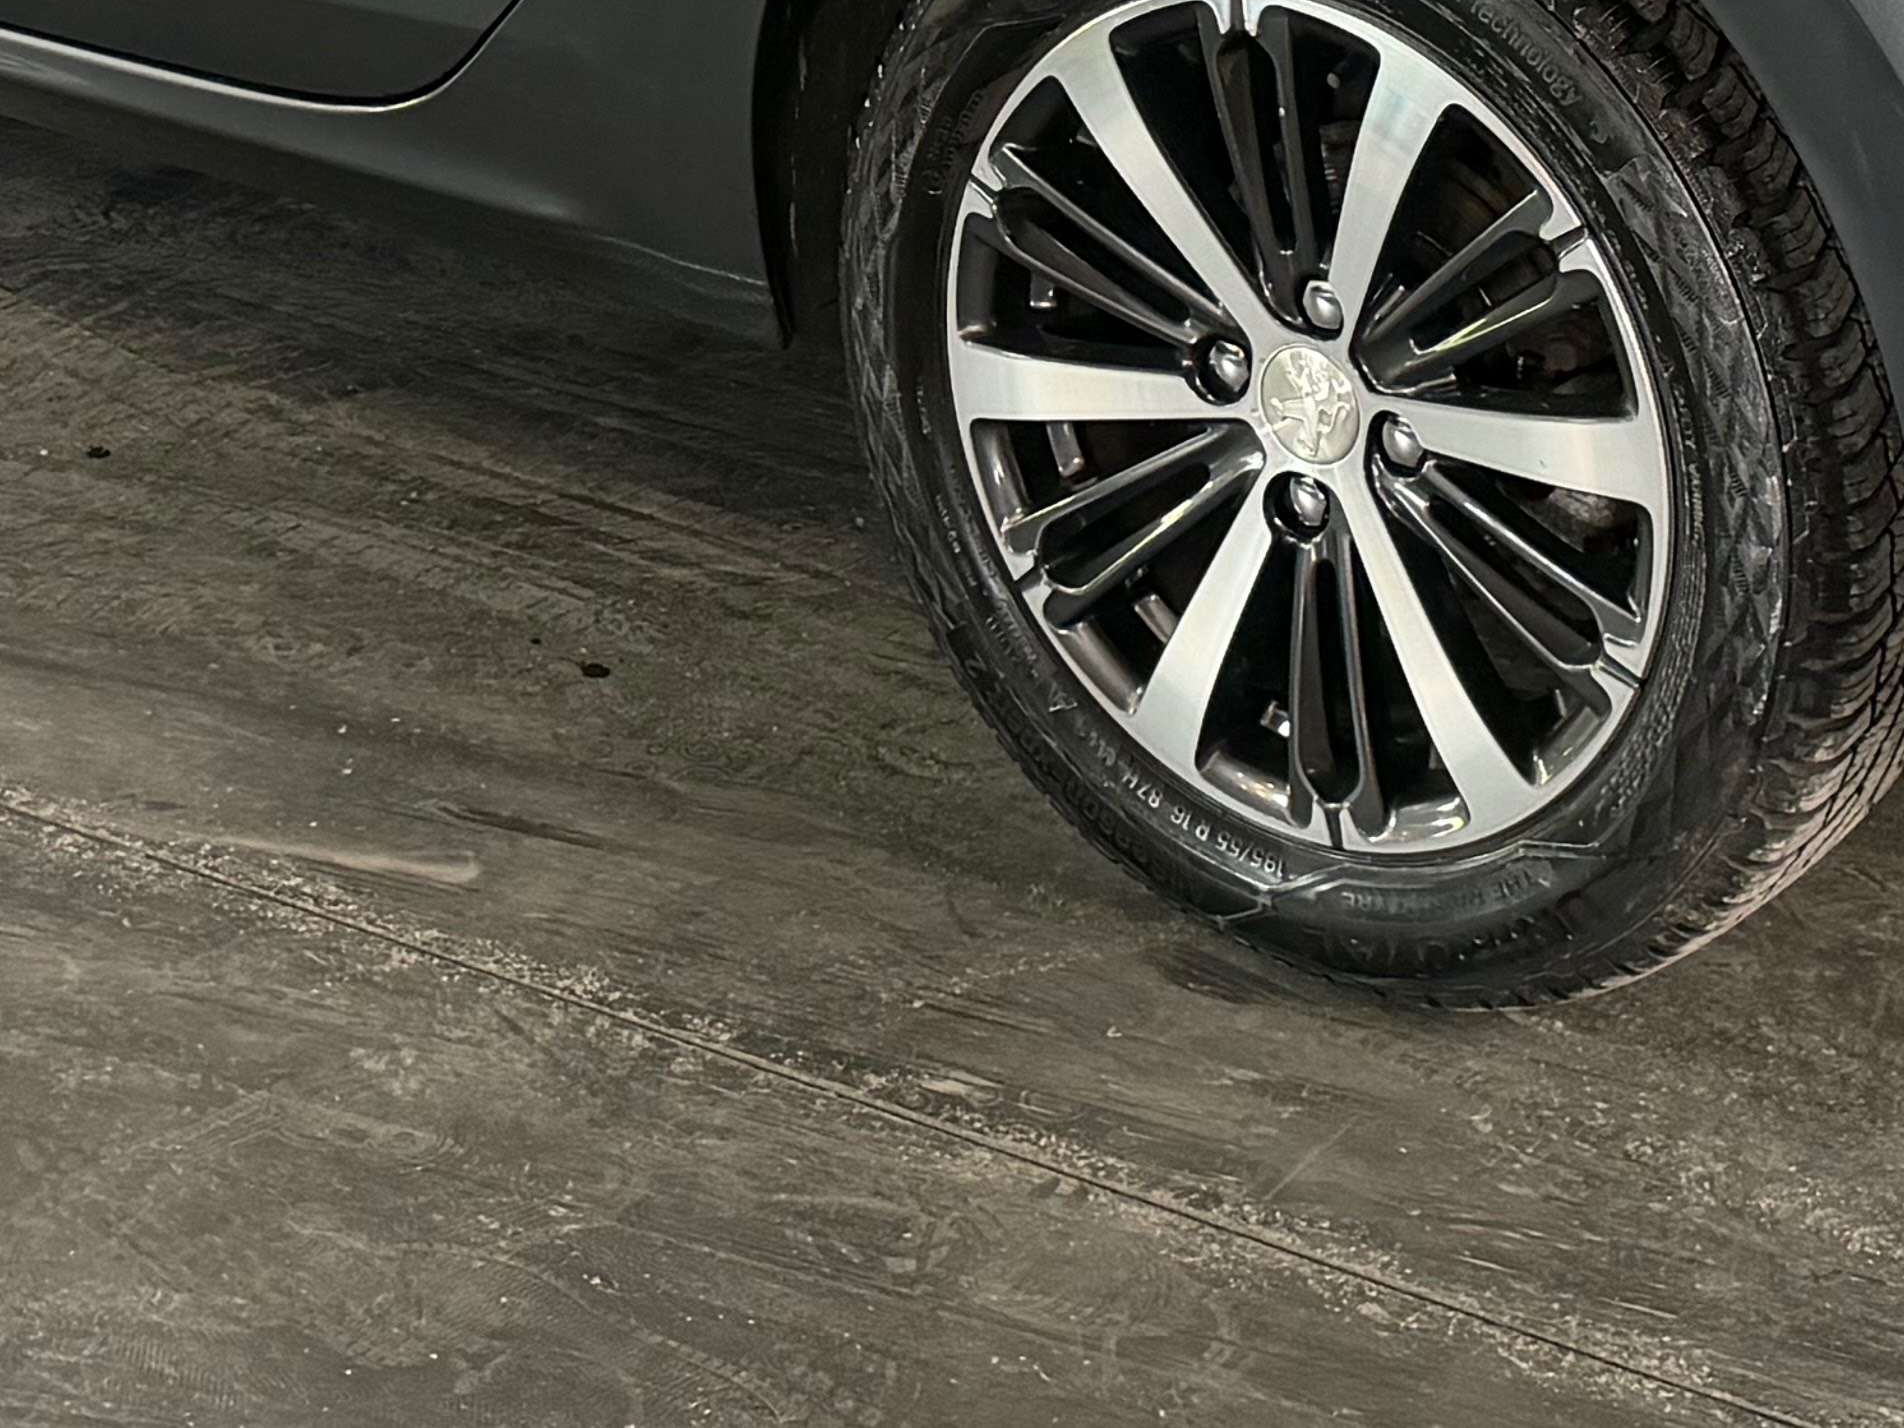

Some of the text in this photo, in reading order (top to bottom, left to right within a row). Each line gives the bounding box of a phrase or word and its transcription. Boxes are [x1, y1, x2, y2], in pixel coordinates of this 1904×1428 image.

[1170, 805, 1193, 833] 16
[1193, 819, 1212, 843] R
[1214, 832, 1287, 879] 195/55
